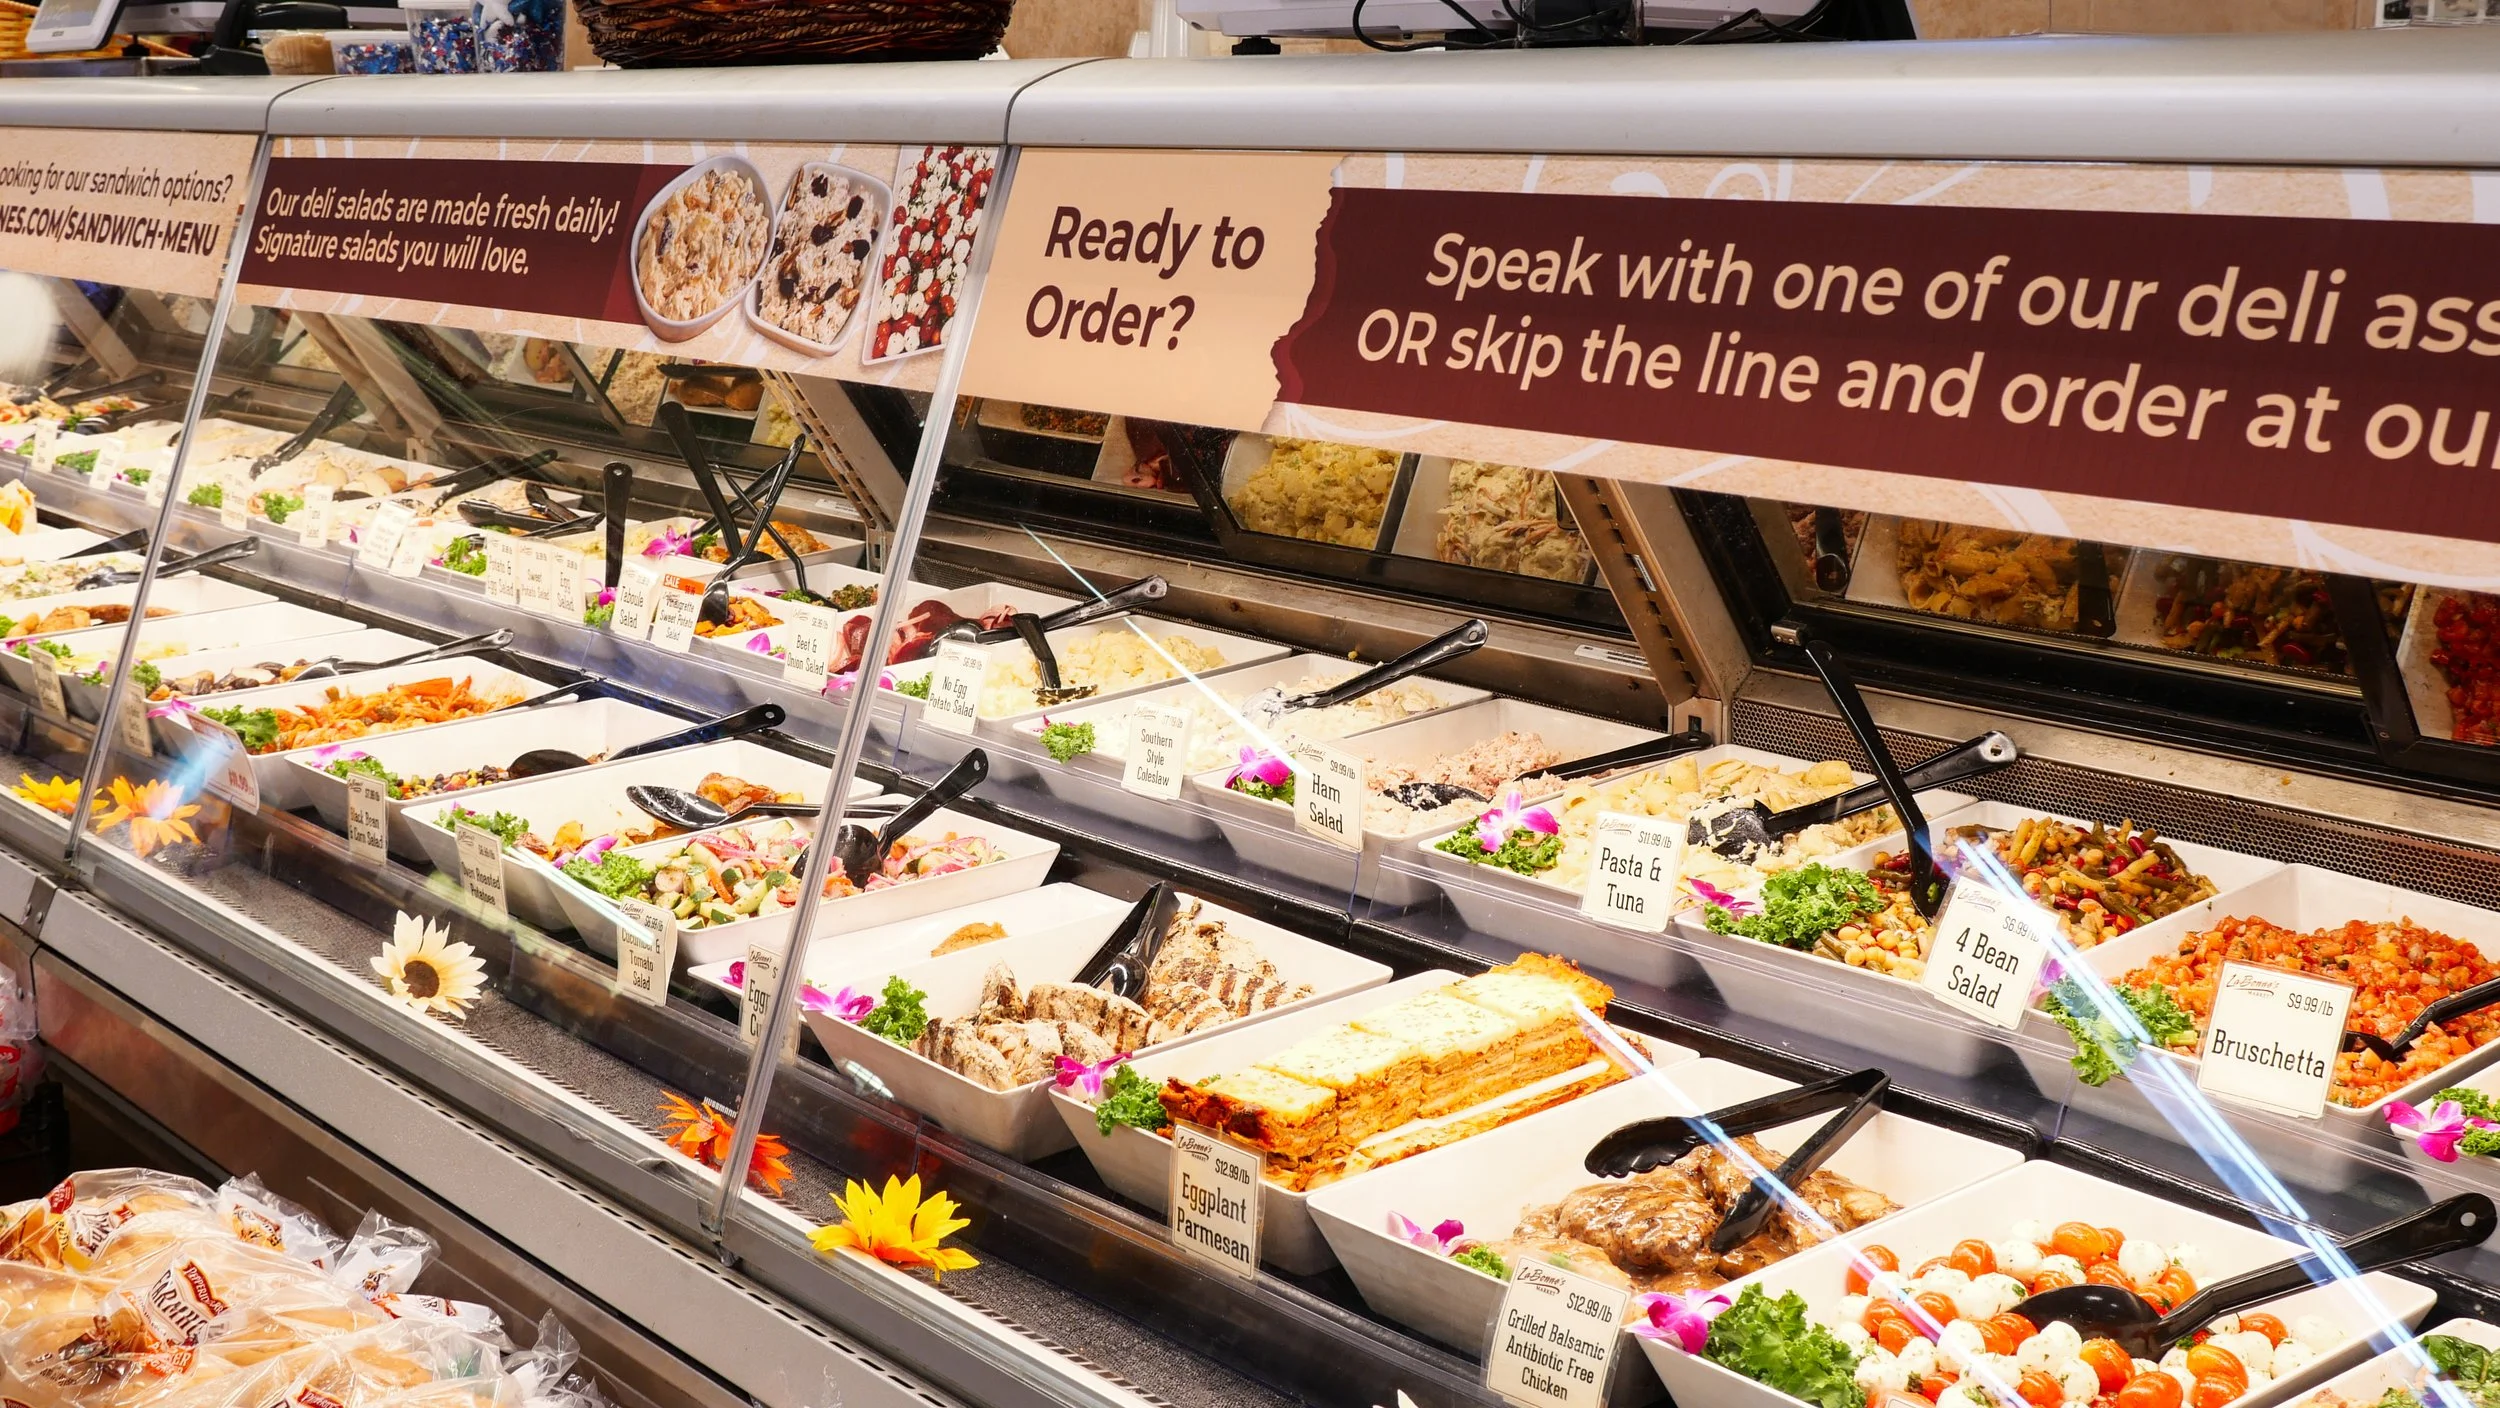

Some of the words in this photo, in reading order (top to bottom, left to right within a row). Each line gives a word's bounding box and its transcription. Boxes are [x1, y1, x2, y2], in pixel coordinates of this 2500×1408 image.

[44, 162, 65, 190] for
[65, 171, 90, 192] our
[90, 166, 160, 198] sandwich
[163, 169, 233, 206] options?
[266, 187, 300, 217] Our
[300, 187, 336, 219] deli
[334, 188, 394, 223] salads
[395, 199, 428, 224] are
[430, 192, 490, 228] made
[494, 193, 551, 231] fresh
[555, 196, 621, 243] daily!
[254, 225, 339, 263] Signature
[338, 230, 399, 264] salads
[396, 238, 443, 273] you
[443, 234, 482, 271] will
[482, 236, 529, 275] love.
[1044, 205, 1203, 280] Ready
[1211, 216, 1265, 270] to
[1425, 232, 1603, 302] Speak
[1618, 239, 1754, 306] with
[1772, 262, 1903, 316] one
[1924, 254, 2011, 322] of
[2018, 275, 2159, 332] our
[2177, 266, 2347, 345] deli
[1025, 284, 1196, 351] Order?
[1357, 309, 1438, 367] OR
[1445, 315, 1564, 391] skip
[1580, 324, 1682, 390] the
[1697, 330, 1820, 403] line
[1837, 351, 1985, 418] and
[2000, 362, 2228, 441] order
[2246, 386, 2341, 454] at
[2364, 403, 2500, 470] ou
[664, 573, 681, 589] SALE
[619, 608, 638, 629] Salad
[659, 609, 677, 624] Sweet
[796, 634, 811, 651] Beet
[811, 639, 818, 654] &
[787, 651, 804, 670] Onion
[805, 657, 825, 676] Salad
[942, 675, 953, 691] No
[953, 678, 968, 700] Egg
[928, 692, 951, 712] Potato
[952, 699, 975, 718] Salad
[1140, 728, 1173, 748] Southern
[1146, 748, 1165, 769] Style
[1330, 759, 1356, 780] $9.99/lb
[1136, 766, 1170, 787] Coleslaw
[1312, 772, 1341, 804] Ham
[350, 806, 364, 825] Black
[364, 811, 380, 830] Bean
[1309, 801, 1344, 835] Salad
[353, 826, 367, 844] Corn
[366, 831, 383, 849] Salad
[1638, 830, 1672, 849] $11.99/lb
[1599, 846, 1643, 878] Pasta
[1649, 856, 1662, 882] &
[475, 867, 501, 890] Roasted
[469, 882, 496, 906] Potatoes
[1607, 882, 1645, 914] Tuna
[2002, 915, 2040, 943] $6.99/lb
[655, 938, 661, 954] &
[1956, 927, 1971, 953] 4
[1972, 932, 2019, 975] Bean
[629, 949, 654, 972] Tomato
[632, 970, 651, 991] Salad
[1947, 964, 2002, 1009] Salad
[2226, 973, 2280, 990] LaBonne's
[2287, 992, 2334, 1017] $9.99/lb
[2211, 1028, 2326, 1079] Bruschetta
[1177, 1135, 1213, 1154] LaBonne's
[1214, 1158, 1250, 1185] $12.99/lb
[1181, 1172, 1247, 1224] Eggplant
[1176, 1206, 1250, 1264] Parmesan
[184, 1266, 211, 1305] PEPPERID
[1516, 1266, 1567, 1287] LaBonne's
[1535, 1285, 1556, 1297] MARKET
[1566, 1292, 1613, 1324] $12.99/lb
[1507, 1308, 1548, 1339] Grilled
[1548, 1323, 1605, 1361] Balsamic
[1505, 1334, 1564, 1373] Antibiotic
[1566, 1357, 1595, 1384] Free
[1521, 1366, 1568, 1401] Chicken
